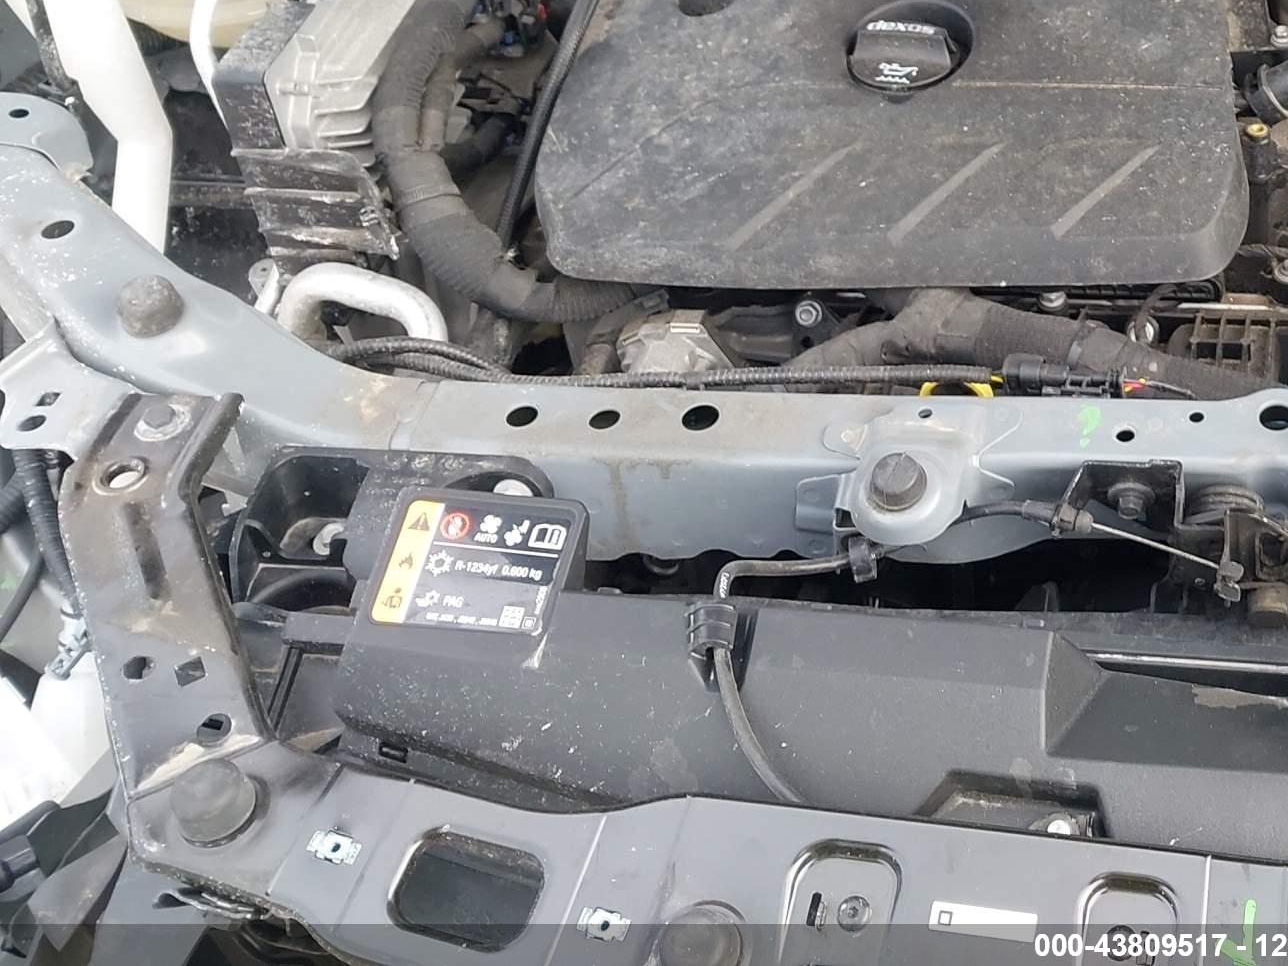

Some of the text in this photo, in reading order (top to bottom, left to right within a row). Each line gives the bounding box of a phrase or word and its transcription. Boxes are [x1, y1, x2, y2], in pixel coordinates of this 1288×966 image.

[866, 19, 936, 35] dexos
[473, 532, 498, 544] AUTO
[455, 560, 499, 576] R-1234yf
[529, 568, 543, 581] kg
[443, 595, 465, 608] PAG
